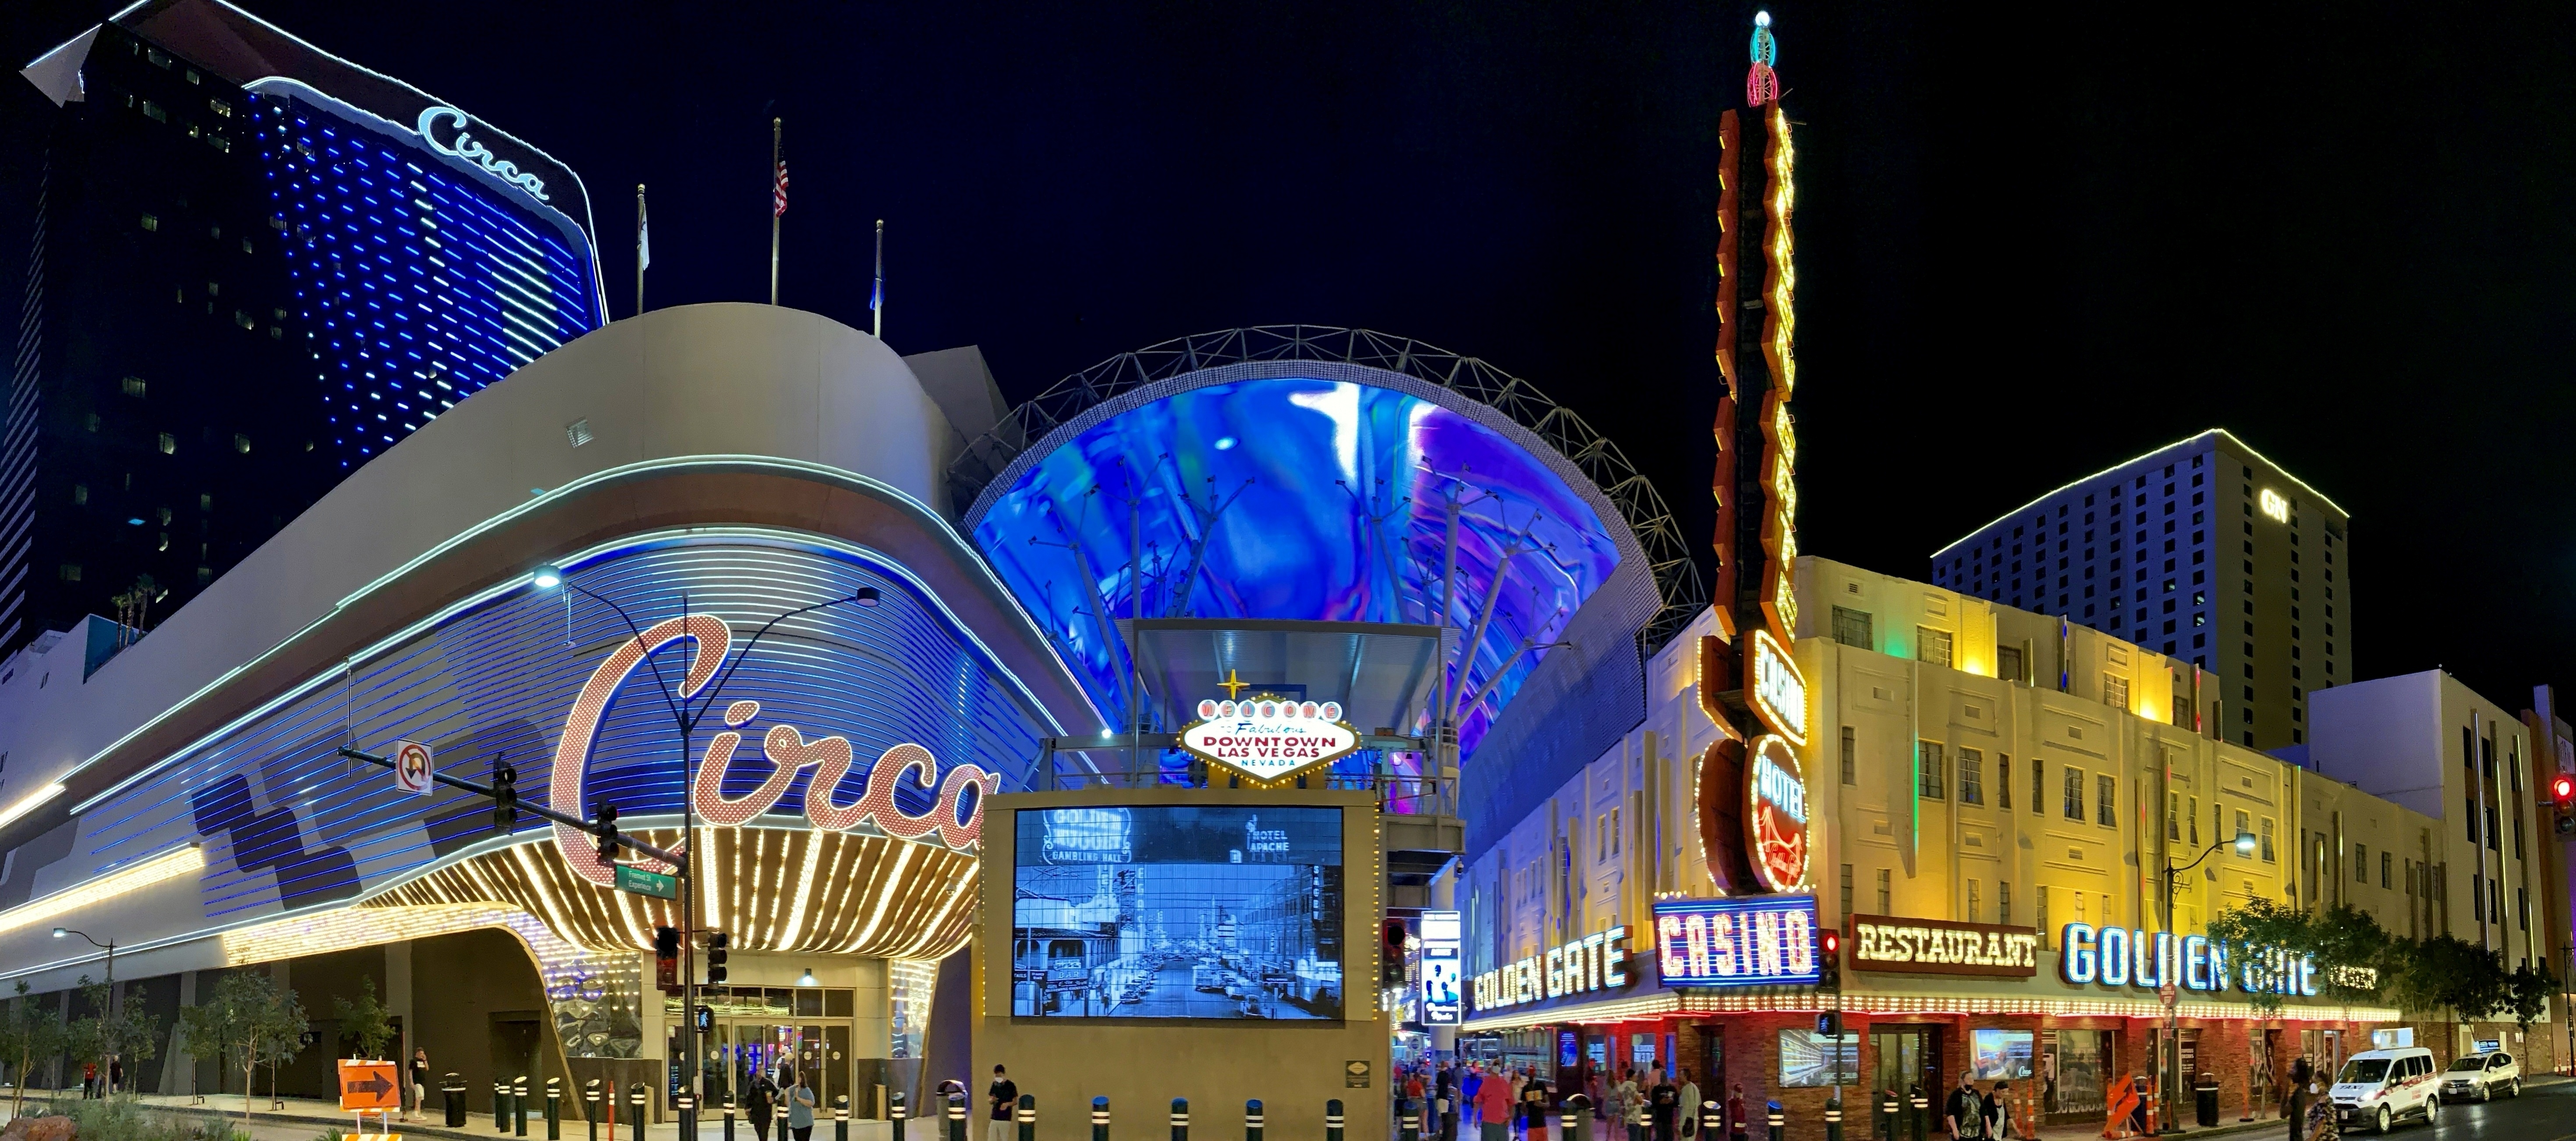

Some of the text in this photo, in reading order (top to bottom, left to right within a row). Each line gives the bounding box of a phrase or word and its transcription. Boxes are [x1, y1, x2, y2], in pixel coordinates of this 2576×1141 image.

[418, 106, 549, 201] Circa
[1775, 107, 1798, 643] GOLDEN GATE
[2261, 489, 2288, 523] GN
[1759, 644, 1806, 735] CASINO
[1201, 702, 1338, 719] WELCOME
[1236, 723, 1307, 735] Fabulous
[551, 613, 1001, 888] Circa
[1203, 737, 1336, 748] DOWNTOWN
[1218, 748, 1320, 758] LAS VEGAS
[1760, 755, 1806, 824] HOTEL
[1250, 842, 1290, 851] APACHE
[1252, 830, 1288, 840] HOTEL
[1052, 850, 1122, 863] GAMBLING HALL
[628, 880, 652, 891] Experience
[1658, 910, 1813, 977] CASINO
[1857, 923, 2037, 967] RESTAURANT
[2065, 922, 2230, 992] GOLDEN
[2242, 941, 2317, 996] GATE
[1473, 925, 1627, 1012] GOLDEN GATE
